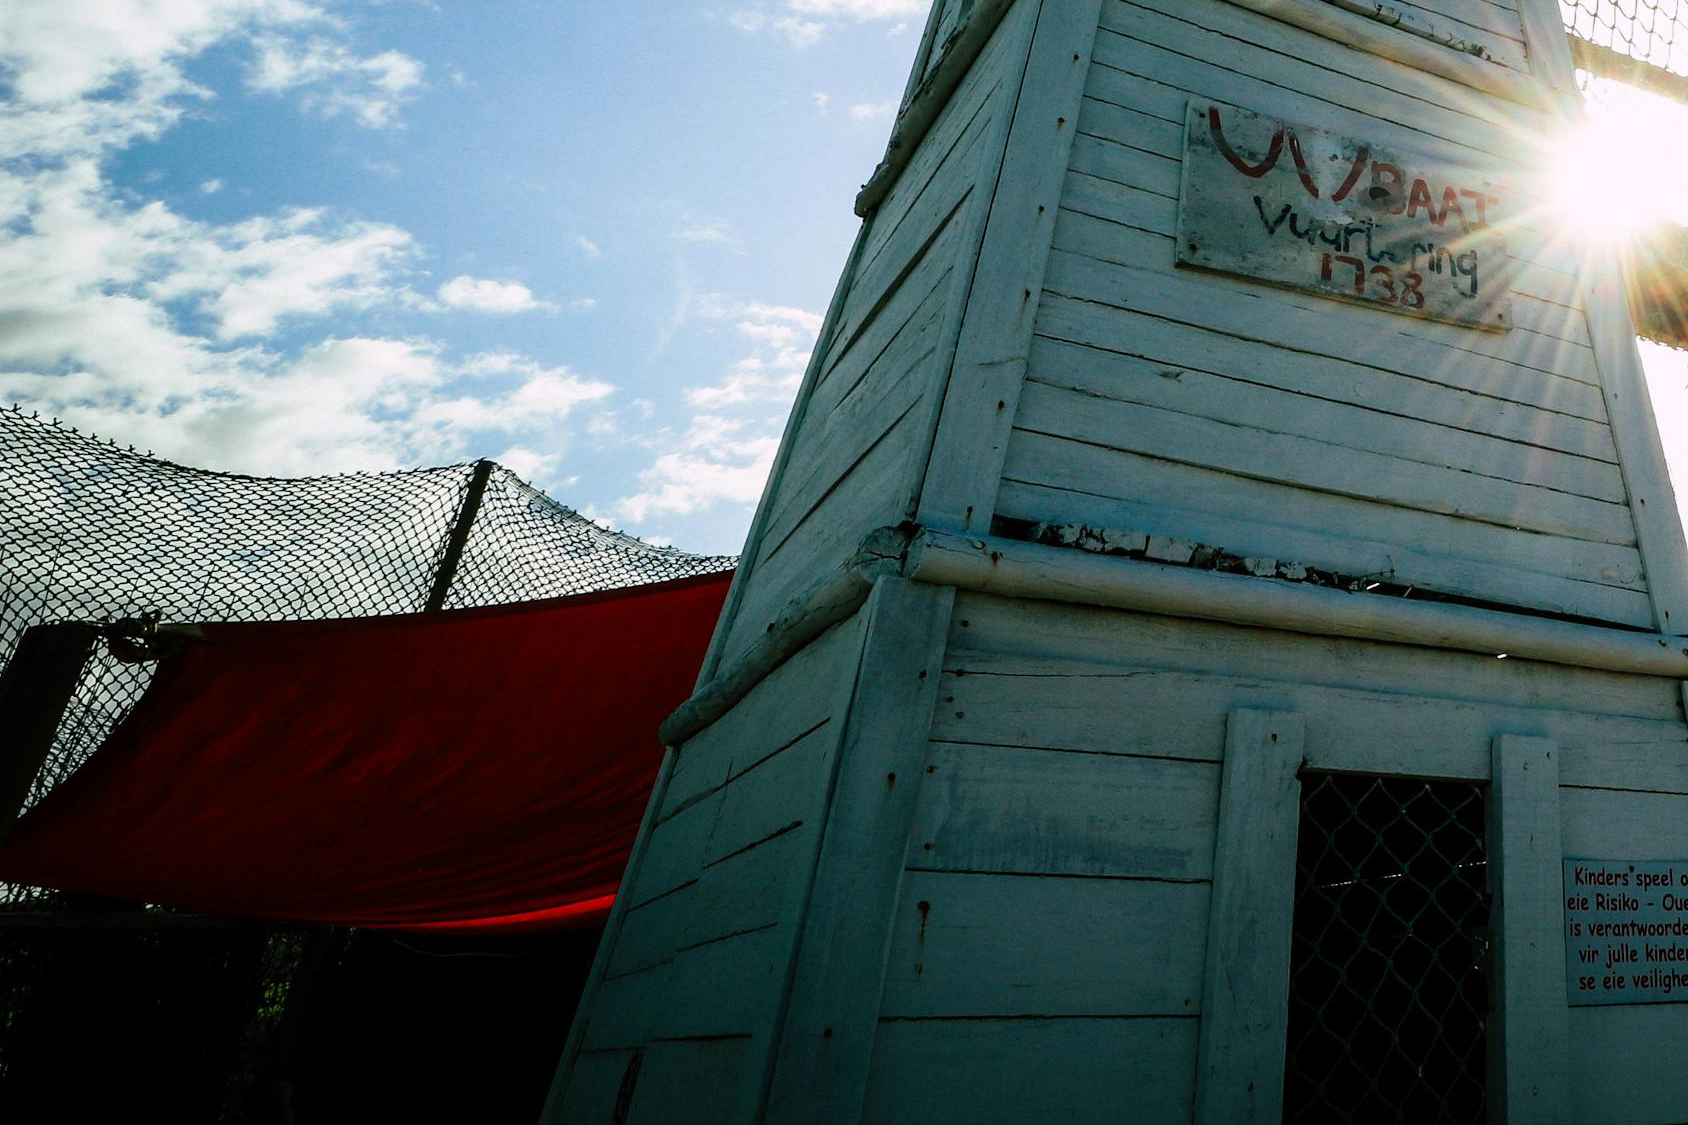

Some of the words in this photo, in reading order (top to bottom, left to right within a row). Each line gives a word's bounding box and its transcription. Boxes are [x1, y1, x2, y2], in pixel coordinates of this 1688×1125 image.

[1320, 252, 1425, 309] 1738
[1574, 866, 1630, 887] Kinders
[1636, 868, 1674, 891] speel
[1567, 894, 1590, 911] eie
[1595, 893, 1640, 911] Risiko
[1569, 918, 1582, 937] is
[1579, 945, 1600, 963] vir
[1605, 943, 1639, 969] julle
[1578, 975, 1596, 990] se
[1602, 971, 1626, 989] eie
